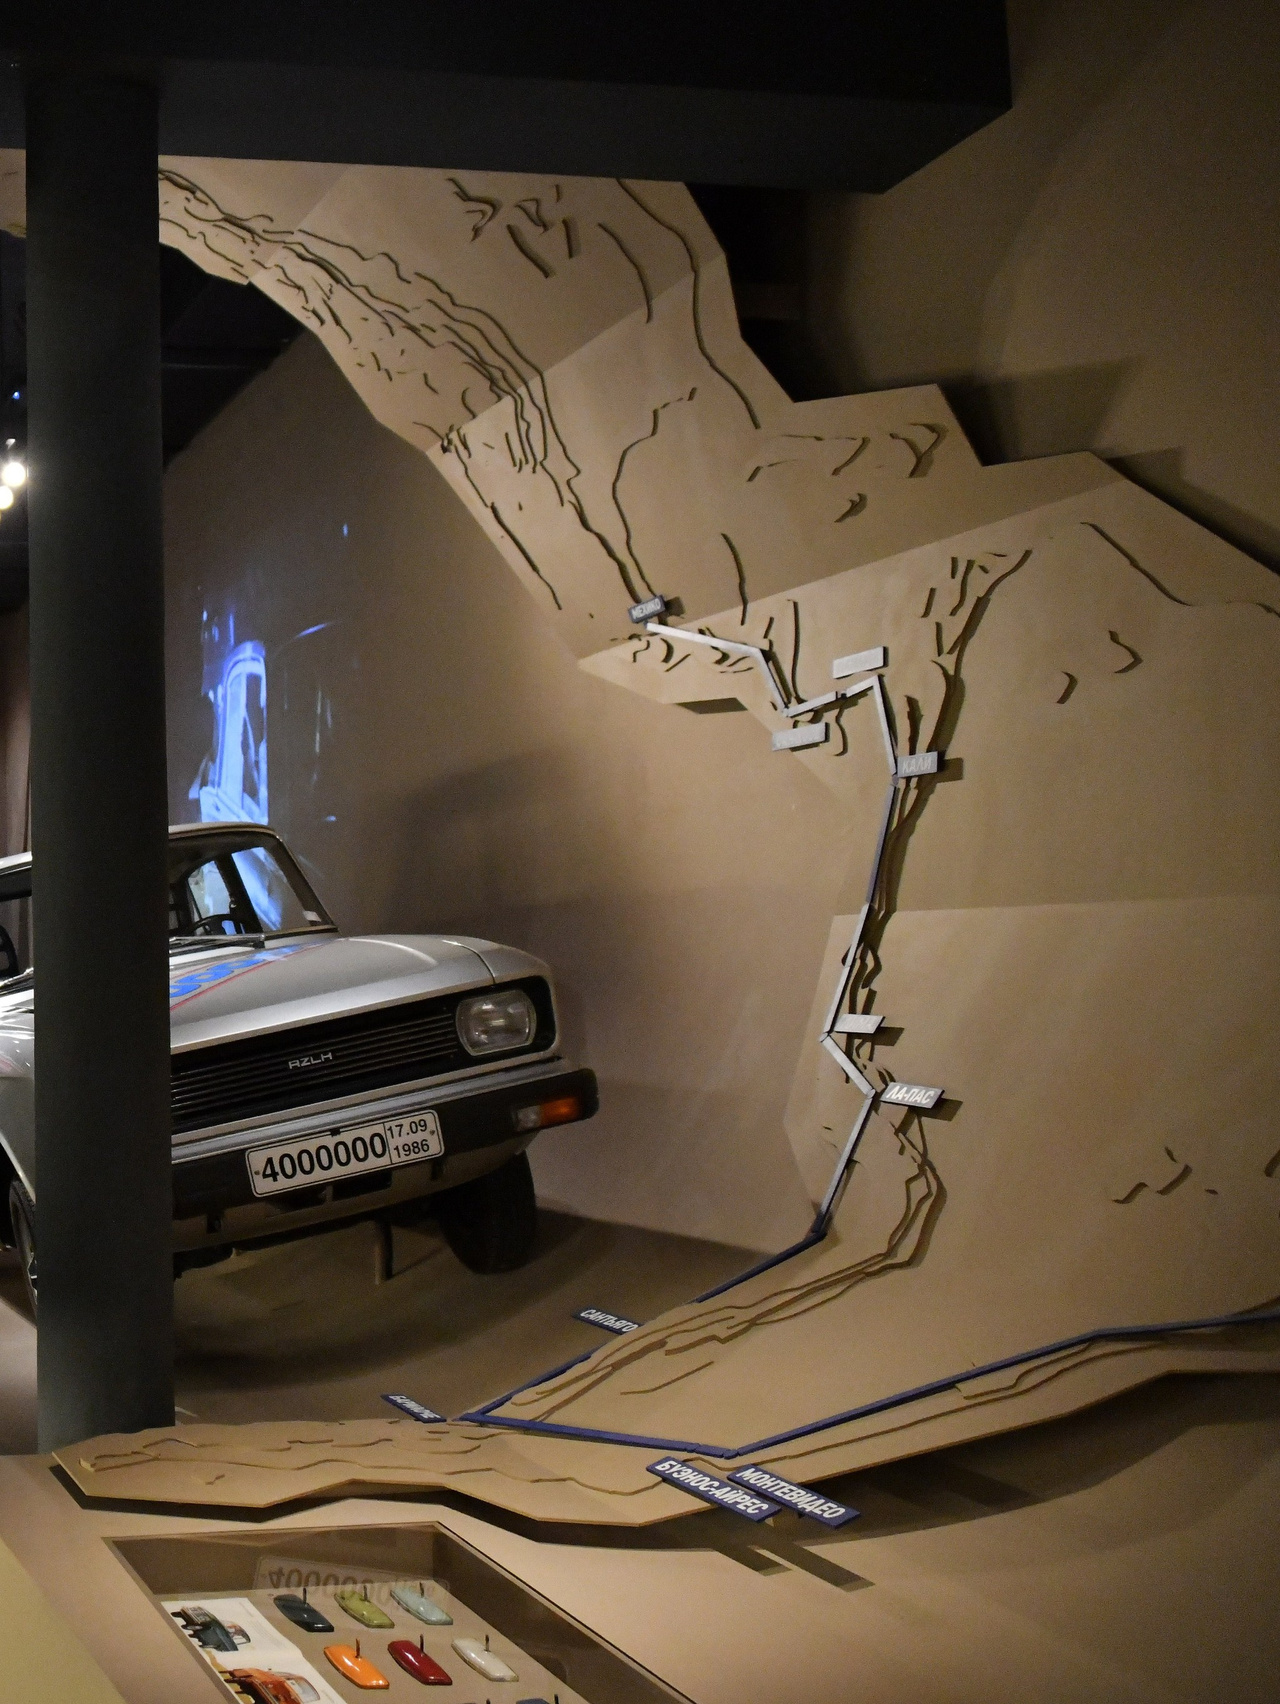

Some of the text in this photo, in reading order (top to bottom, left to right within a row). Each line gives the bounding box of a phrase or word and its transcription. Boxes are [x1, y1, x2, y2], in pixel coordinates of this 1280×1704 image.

[885, 1085, 936, 1104] ЛА-ПАС
[386, 1118, 428, 1140] 17.09
[261, 1132, 388, 1183] 4000000
[393, 1139, 430, 1159] 1986
[580, 1309, 639, 1332] САНТЬЯГО
[654, 1460, 770, 1514] БУЭНОС-АЙРЕС
[736, 1467, 846, 1518] МОНТЕВИДЕО
